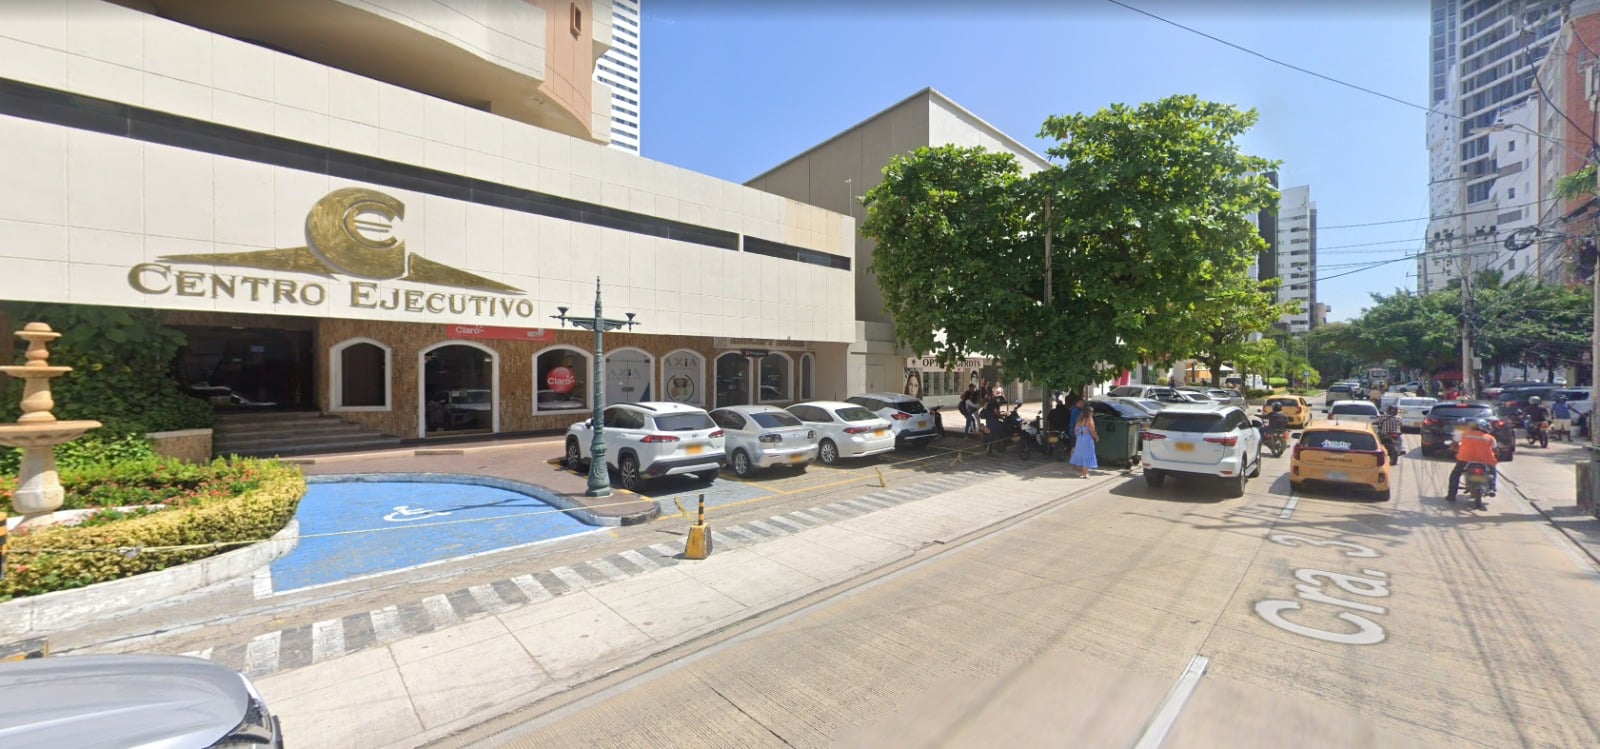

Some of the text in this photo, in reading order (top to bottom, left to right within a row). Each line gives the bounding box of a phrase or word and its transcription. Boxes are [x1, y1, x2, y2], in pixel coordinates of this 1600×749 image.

[127, 262, 534, 318] CENTRO EJECUTIVO
[455, 325, 482, 334] Claro
[547, 376, 573, 385] Claro
